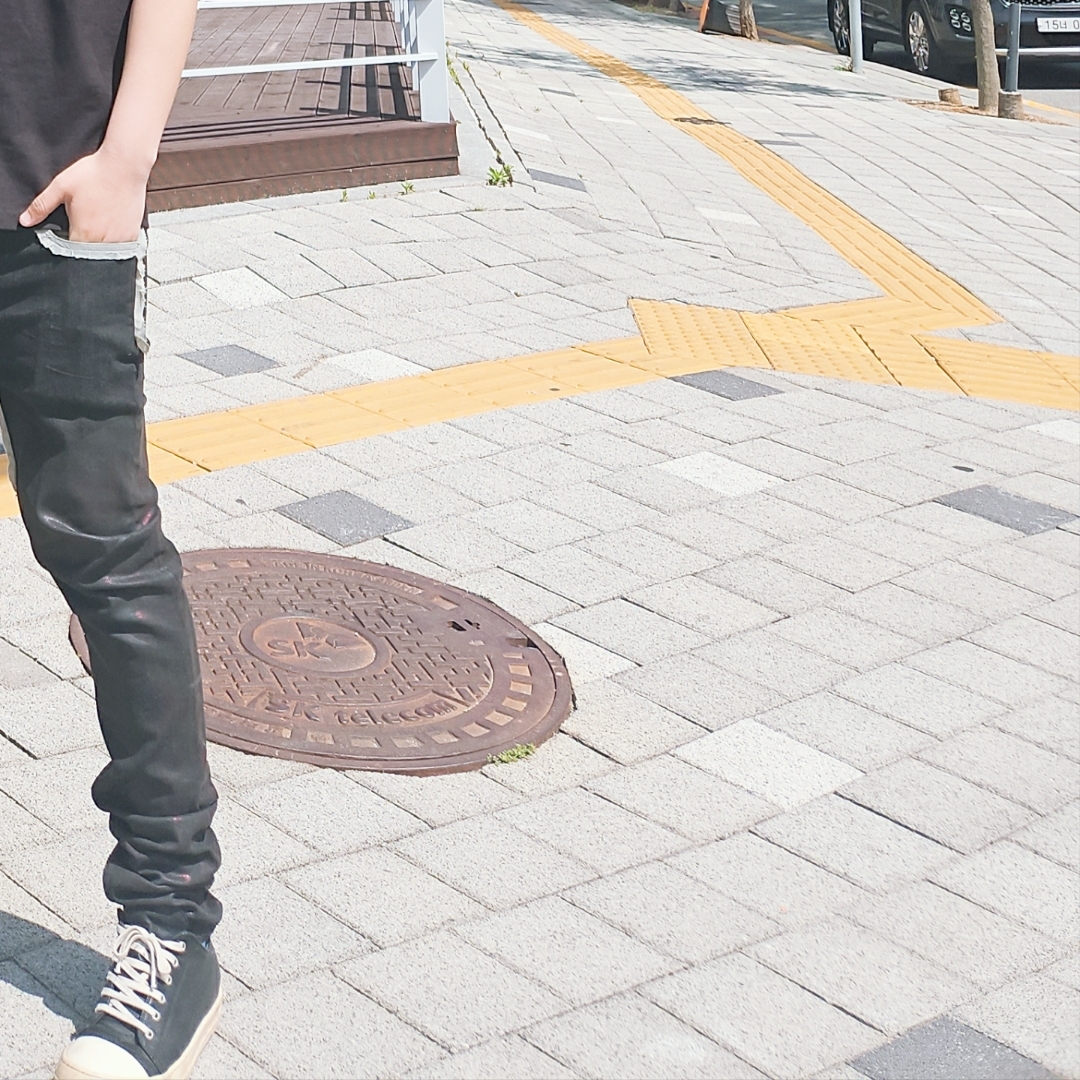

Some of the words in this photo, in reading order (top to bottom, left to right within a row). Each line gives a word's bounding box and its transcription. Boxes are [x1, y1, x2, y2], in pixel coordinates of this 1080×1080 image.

[268, 637, 323, 660] SK
[264, 696, 321, 722] SK
[335, 698, 458, 725] telecom
